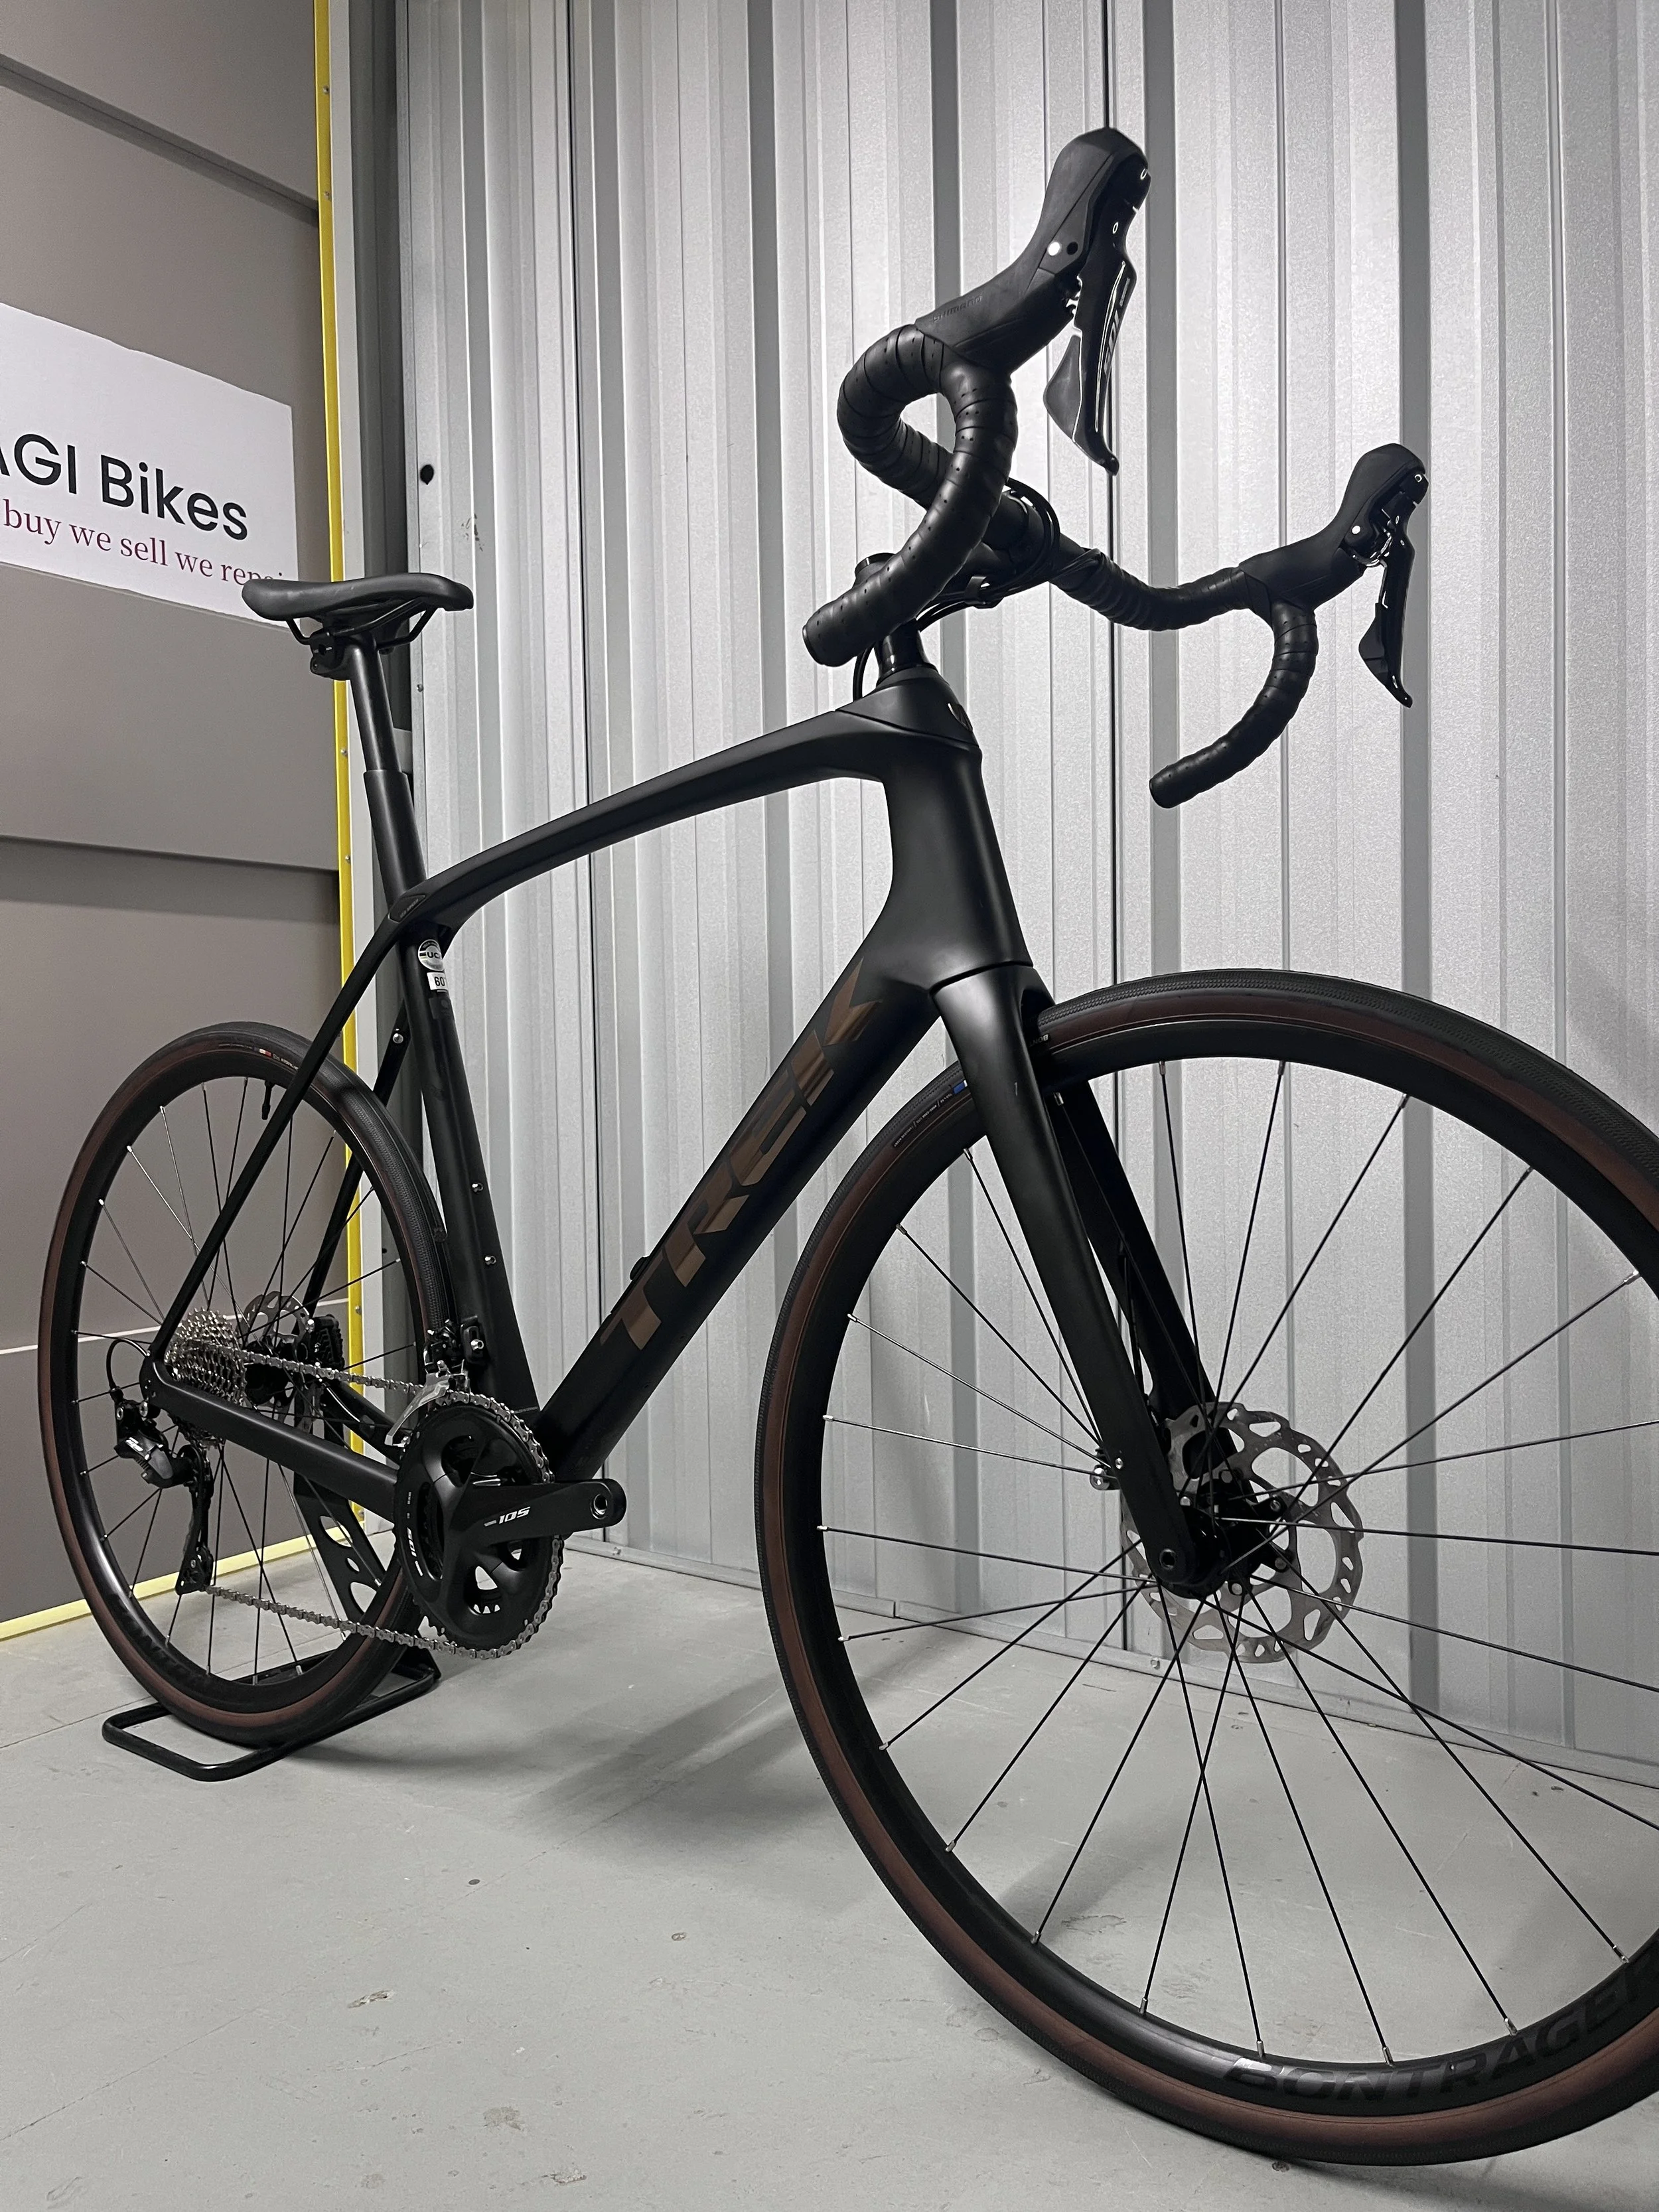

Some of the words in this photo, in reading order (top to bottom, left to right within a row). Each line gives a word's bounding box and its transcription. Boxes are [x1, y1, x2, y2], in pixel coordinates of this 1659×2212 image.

[100, 454, 248, 540] Bikes
[3, 498, 62, 545] buy
[68, 524, 111, 552] we
[120, 538, 169, 566] sell
[175, 552, 213, 577] we
[498, 1506, 531, 1524] 105
